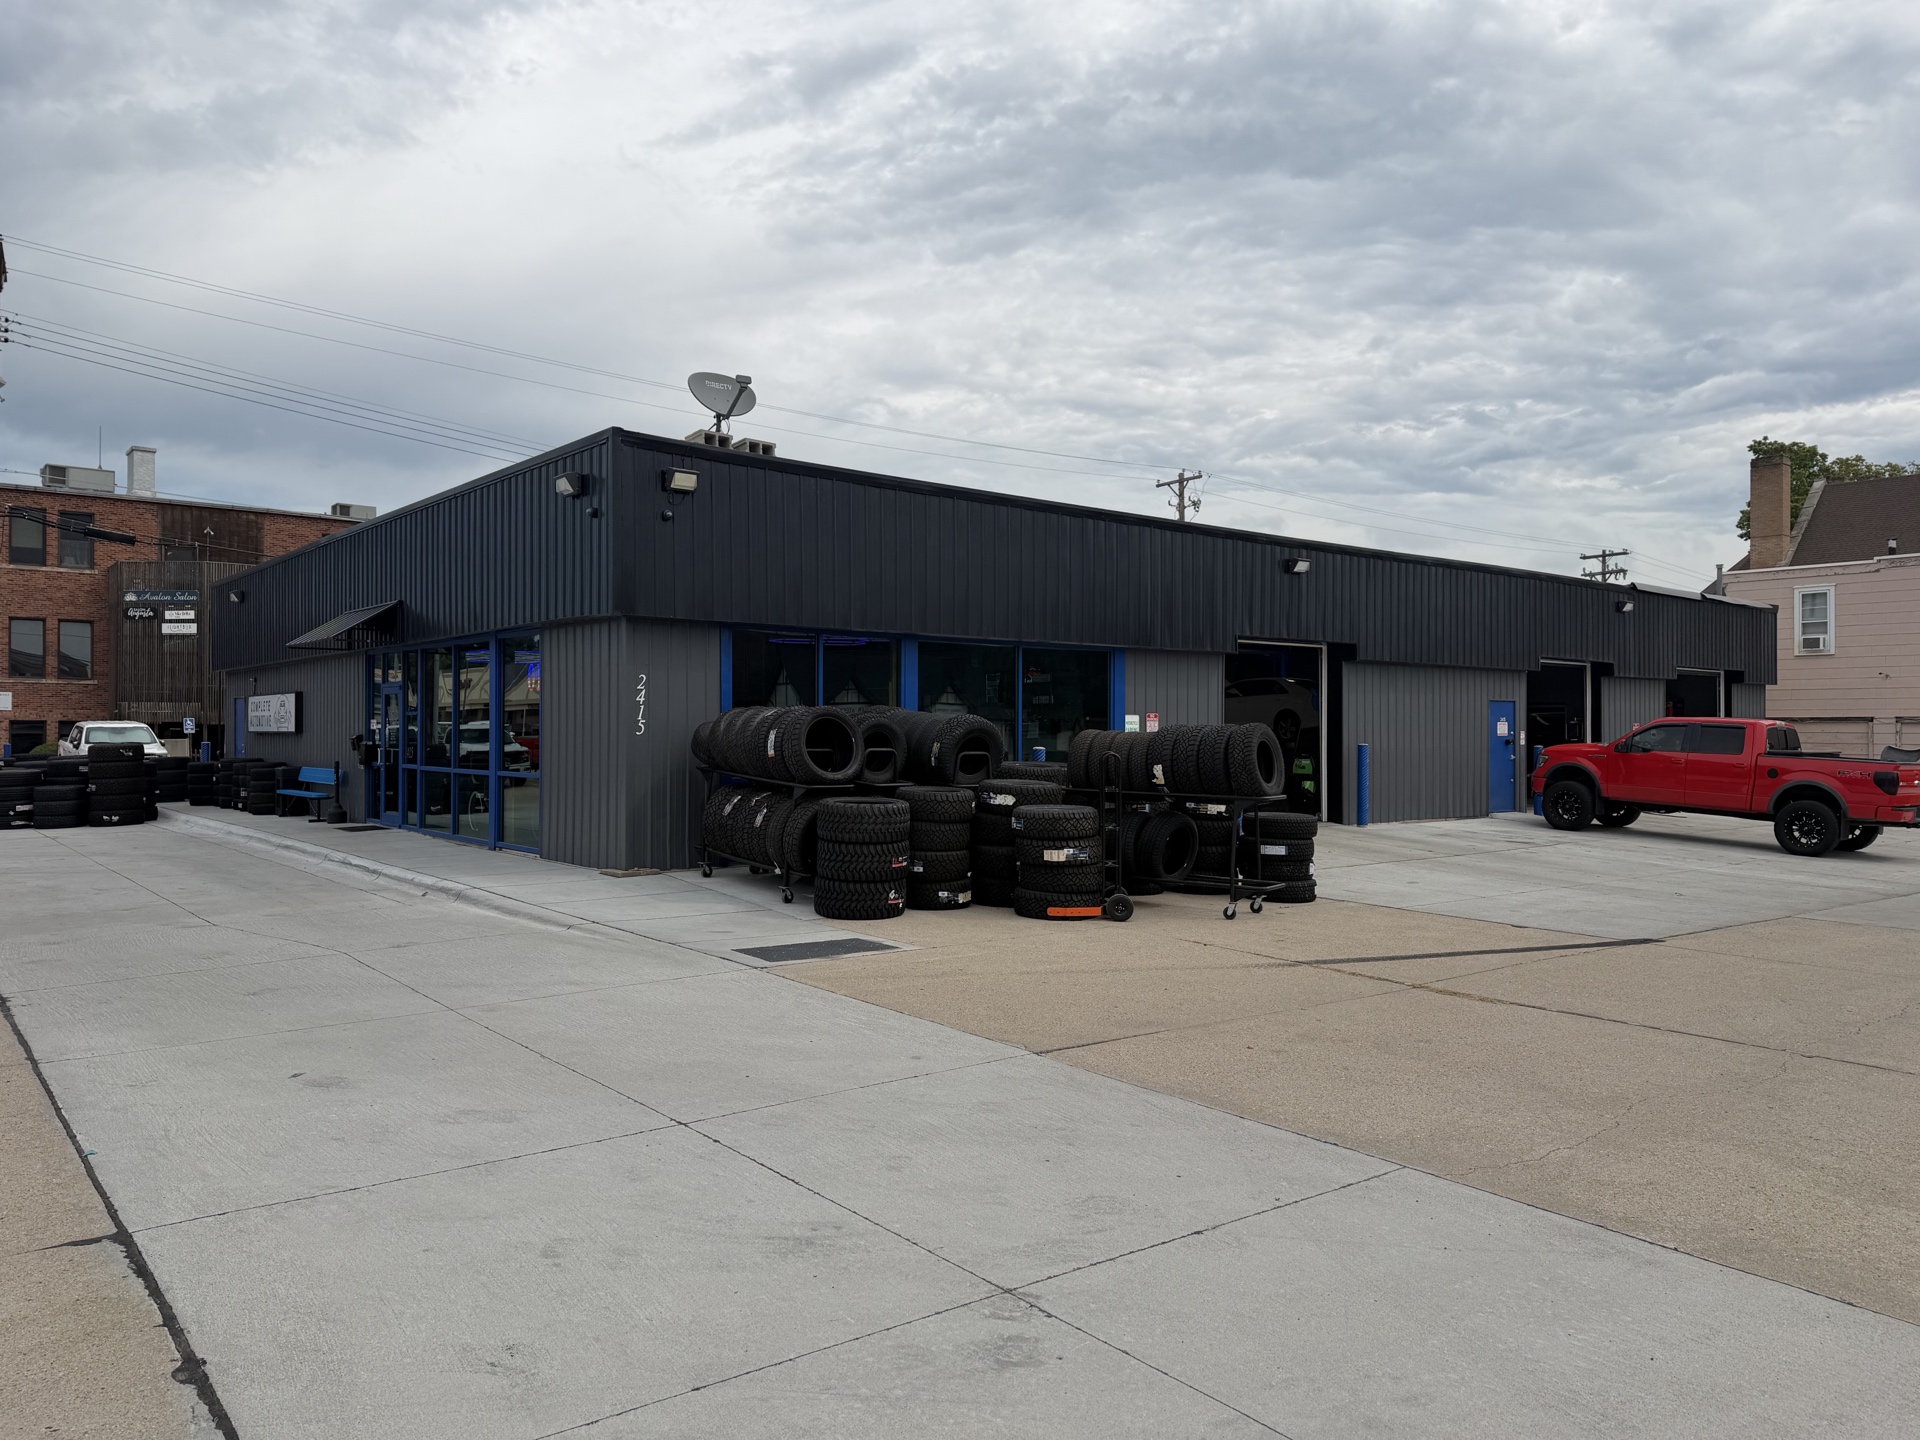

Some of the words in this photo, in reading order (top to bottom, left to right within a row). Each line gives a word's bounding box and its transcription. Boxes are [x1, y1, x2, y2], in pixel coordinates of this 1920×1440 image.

[705, 380, 732, 390] DIRECTV
[139, 592, 171, 601] Avalon
[173, 591, 198, 601] Salon
[127, 607, 155, 620] Augusta
[250, 700, 271, 712] COMPLETE
[636, 674, 647, 735] 2415
[250, 714, 272, 727] AUTOMOTIVE
